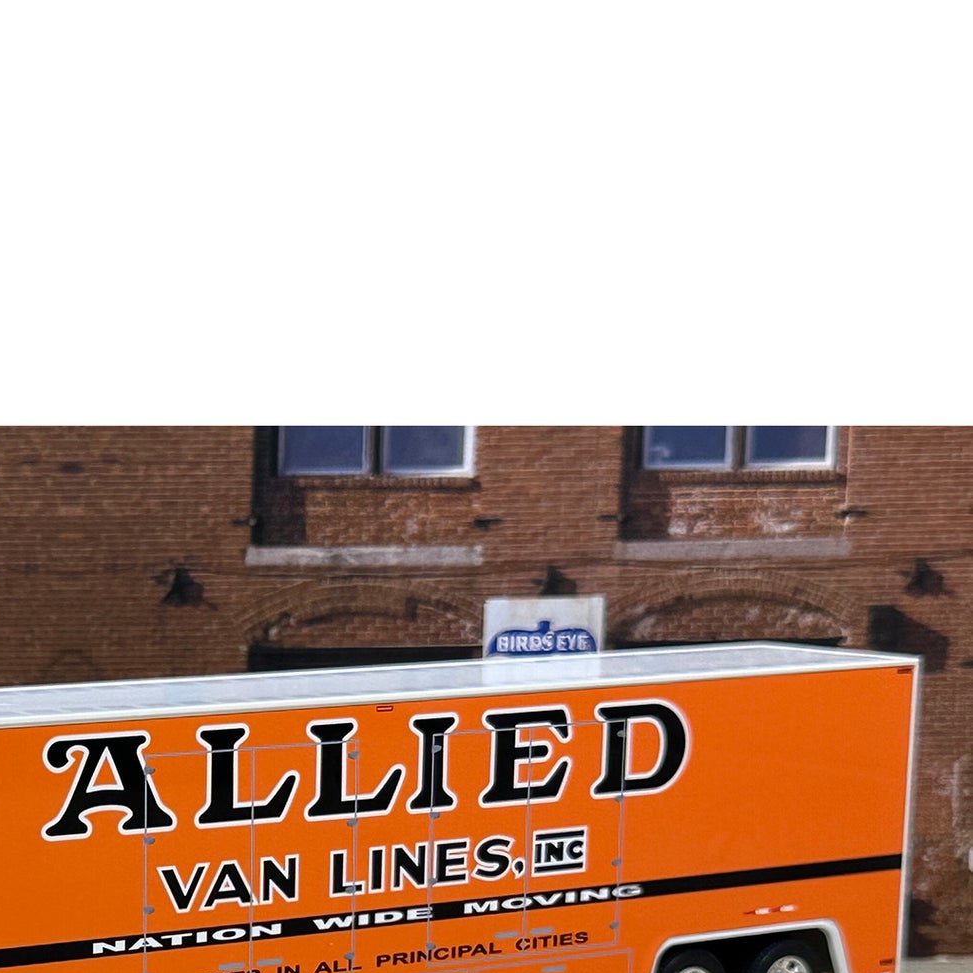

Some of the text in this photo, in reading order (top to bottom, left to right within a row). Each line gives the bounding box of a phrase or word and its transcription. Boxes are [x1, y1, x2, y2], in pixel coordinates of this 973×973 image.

[496, 631, 589, 653] BIRDS EYE
[41, 698, 691, 841] ALLIED
[157, 835, 584, 913] VAN LINES, INC
[92, 884, 645, 954] NATION WIDE MOVING
[376, 942, 502, 967] PRINCIPAL
[515, 931, 589, 952] CITIES
